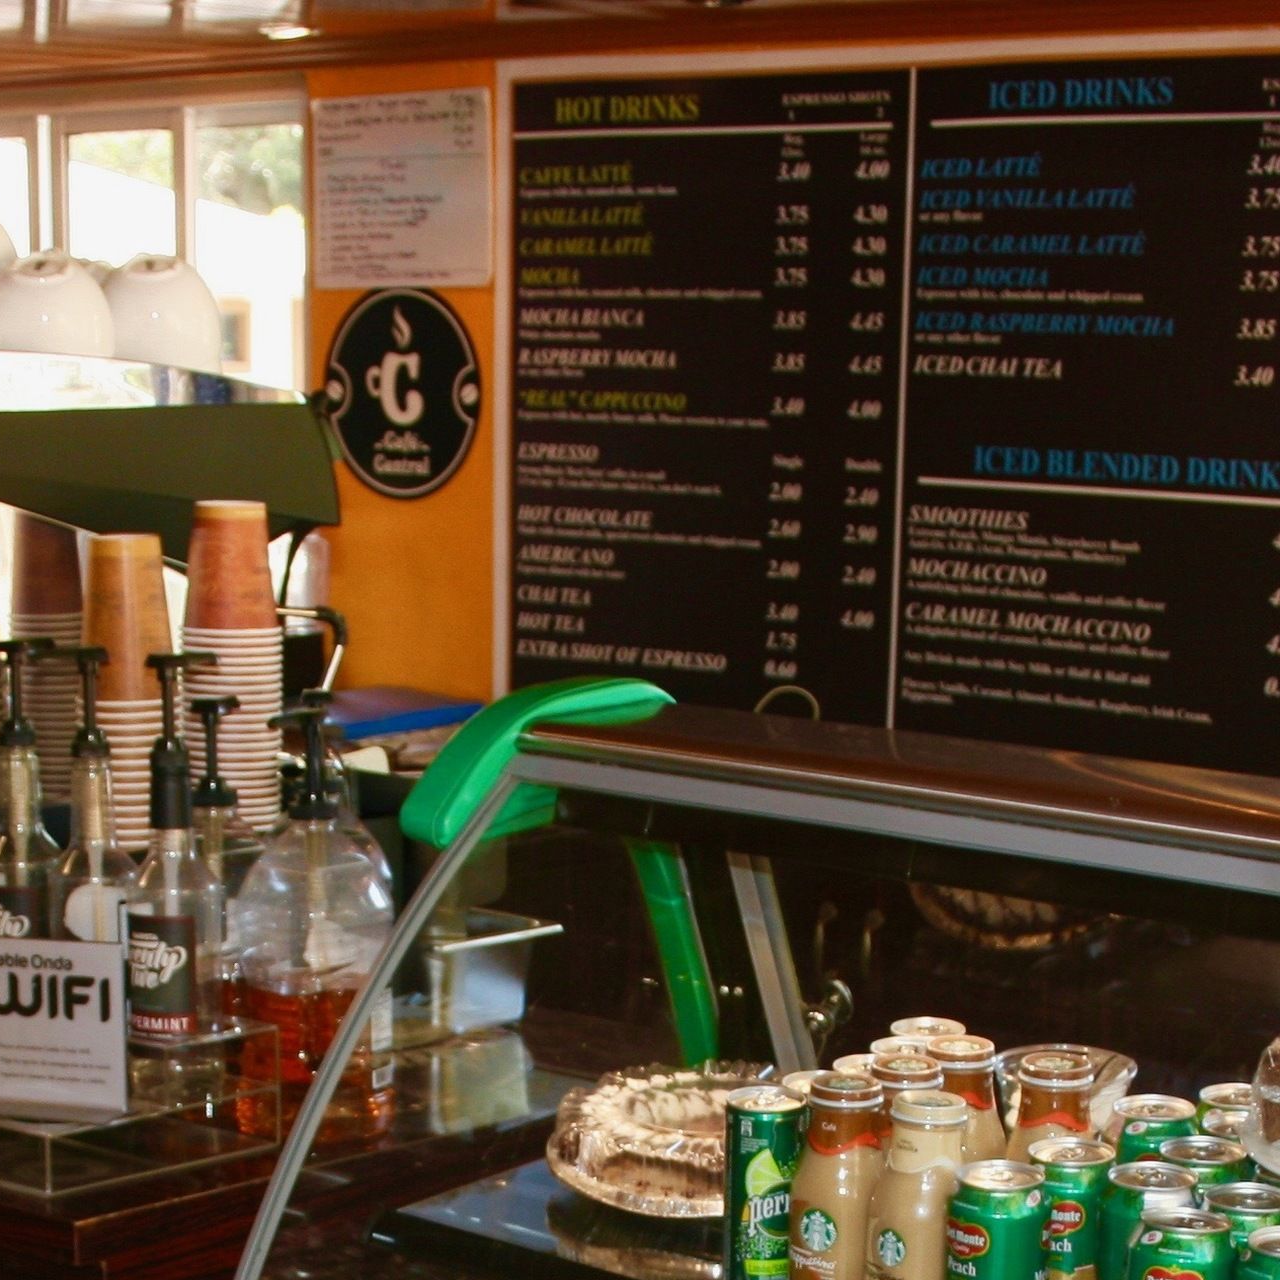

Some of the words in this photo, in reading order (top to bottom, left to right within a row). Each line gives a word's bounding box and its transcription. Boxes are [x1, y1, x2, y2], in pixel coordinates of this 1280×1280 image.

[989, 80, 1057, 110] ICED
[1064, 77, 1174, 108] DRINKS
[554, 97, 607, 124] HOT
[609, 94, 700, 122] DRINKS
[921, 158, 973, 178] ICED
[914, 354, 965, 376] ICED
[1023, 357, 1064, 379] TEA
[973, 445, 1041, 475] ICED
[1046, 448, 1180, 483] BLENDED
[909, 503, 1030, 531] SMOOTHIES
[908, 558, 1047, 587] MOCHACCINO
[905, 602, 1001, 629] CARAMEL
[1007, 610, 1152, 644] MOCHACCINO
[30, 954, 73, 971] Onda
